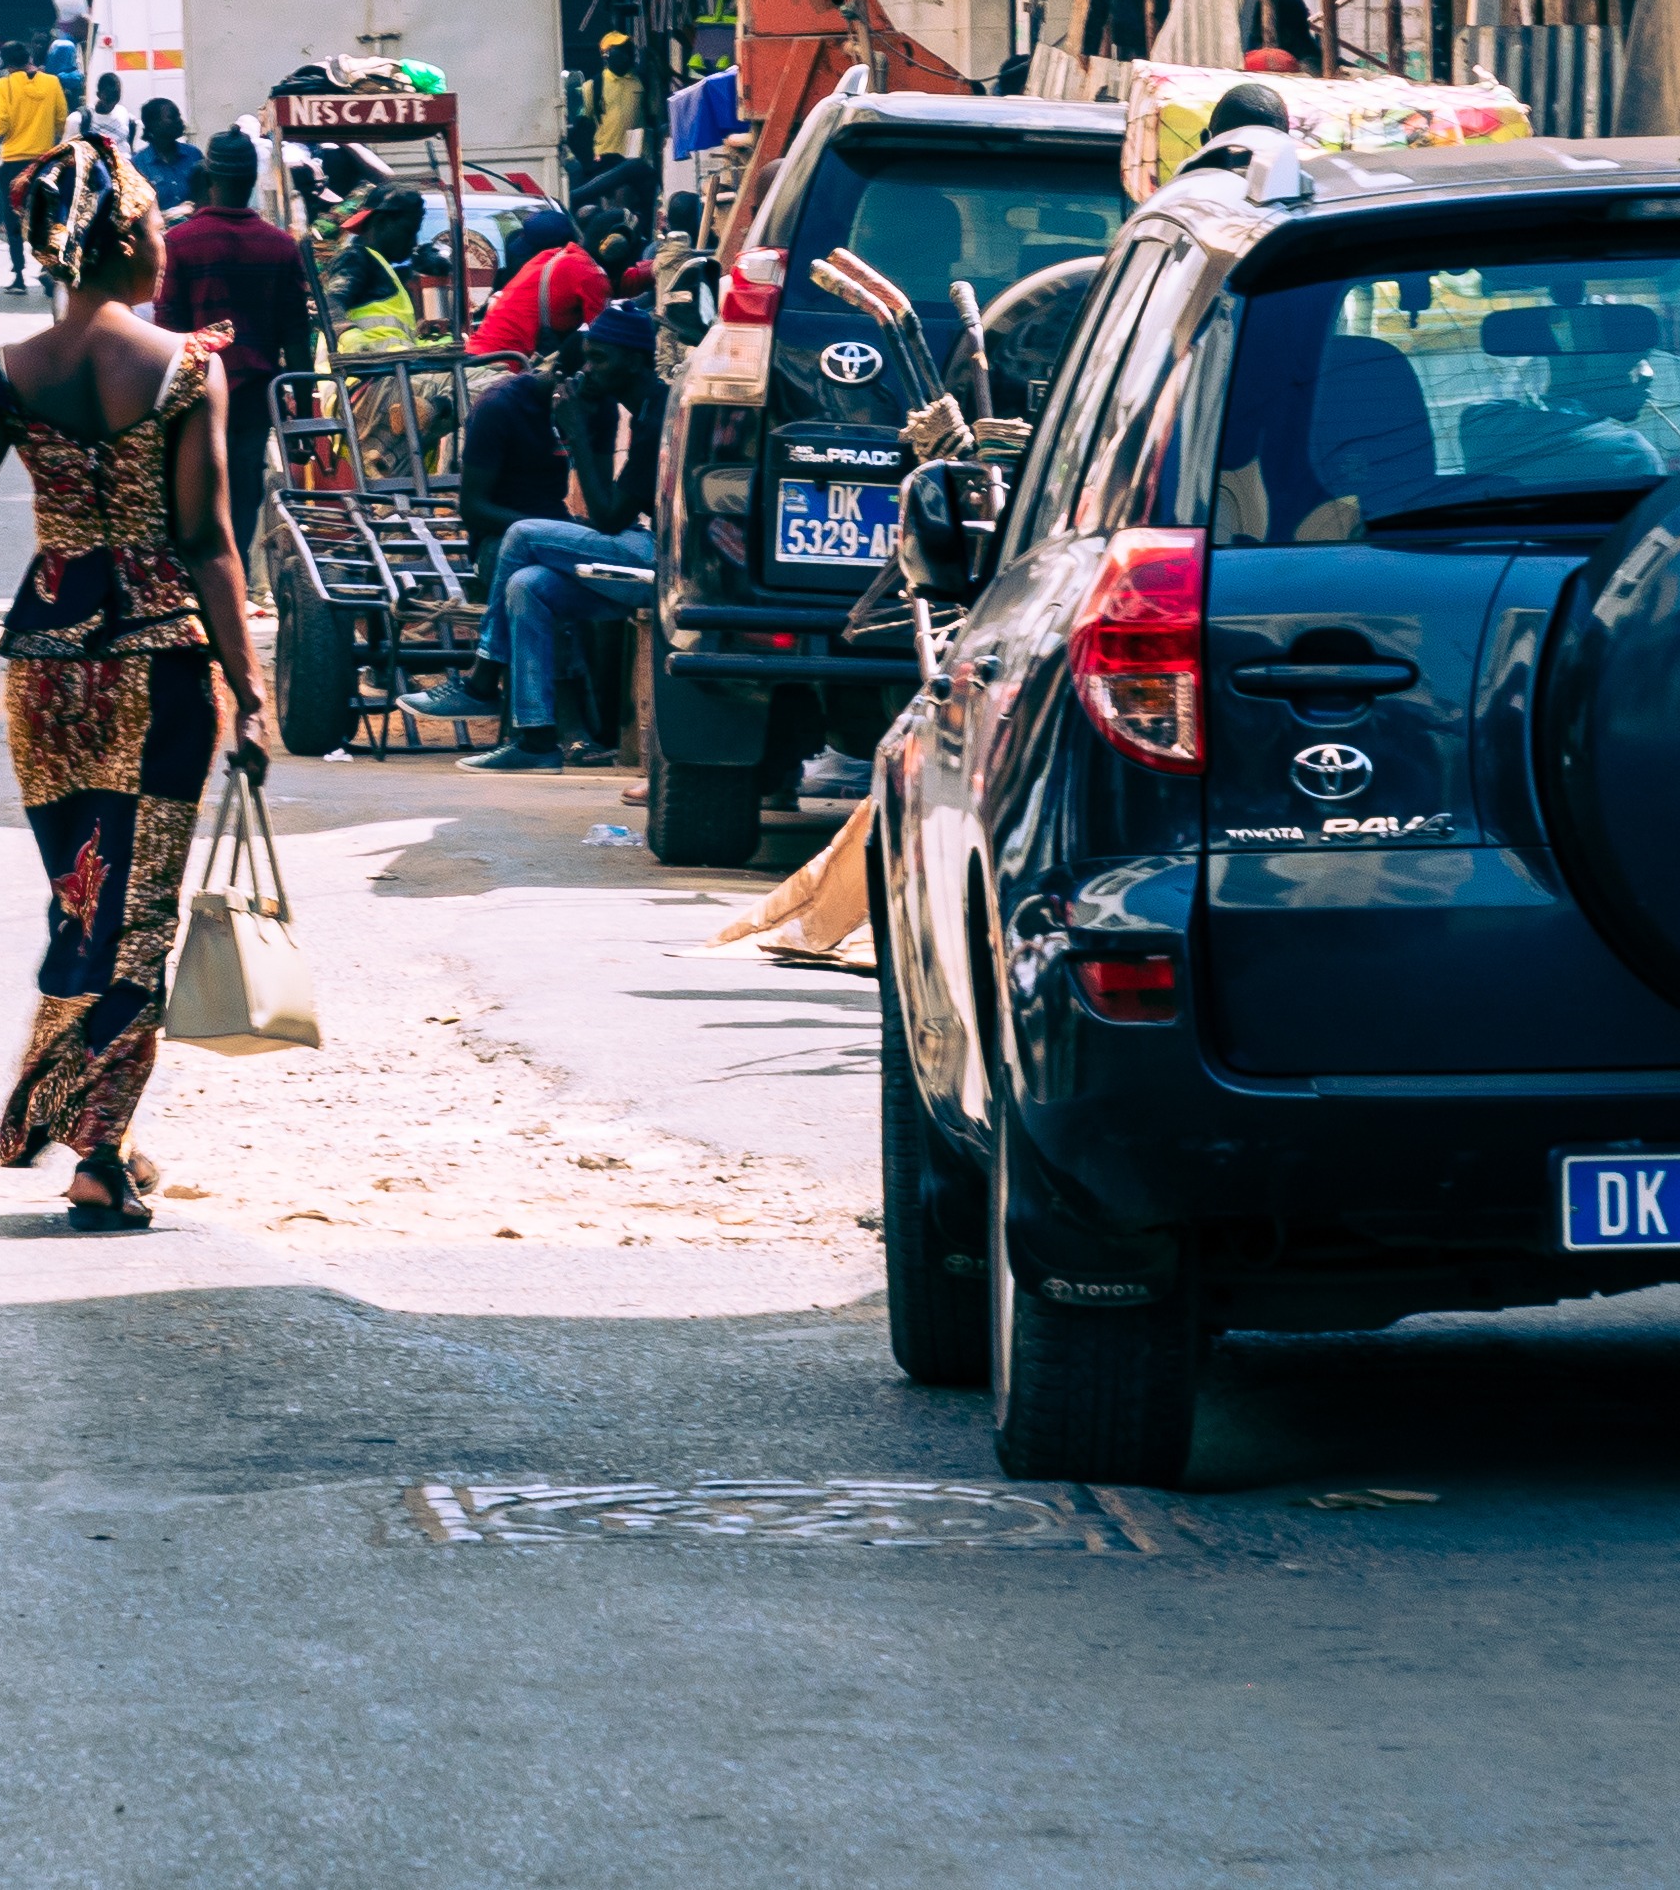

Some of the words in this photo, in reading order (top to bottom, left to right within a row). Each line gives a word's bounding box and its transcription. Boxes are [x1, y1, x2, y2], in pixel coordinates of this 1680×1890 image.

[290, 94, 428, 127] NESCAFE
[826, 447, 901, 466] PRADO
[827, 485, 863, 521] DK
[1225, 826, 1305, 842] TOYOTA
[1597, 1170, 1669, 1236] DK
